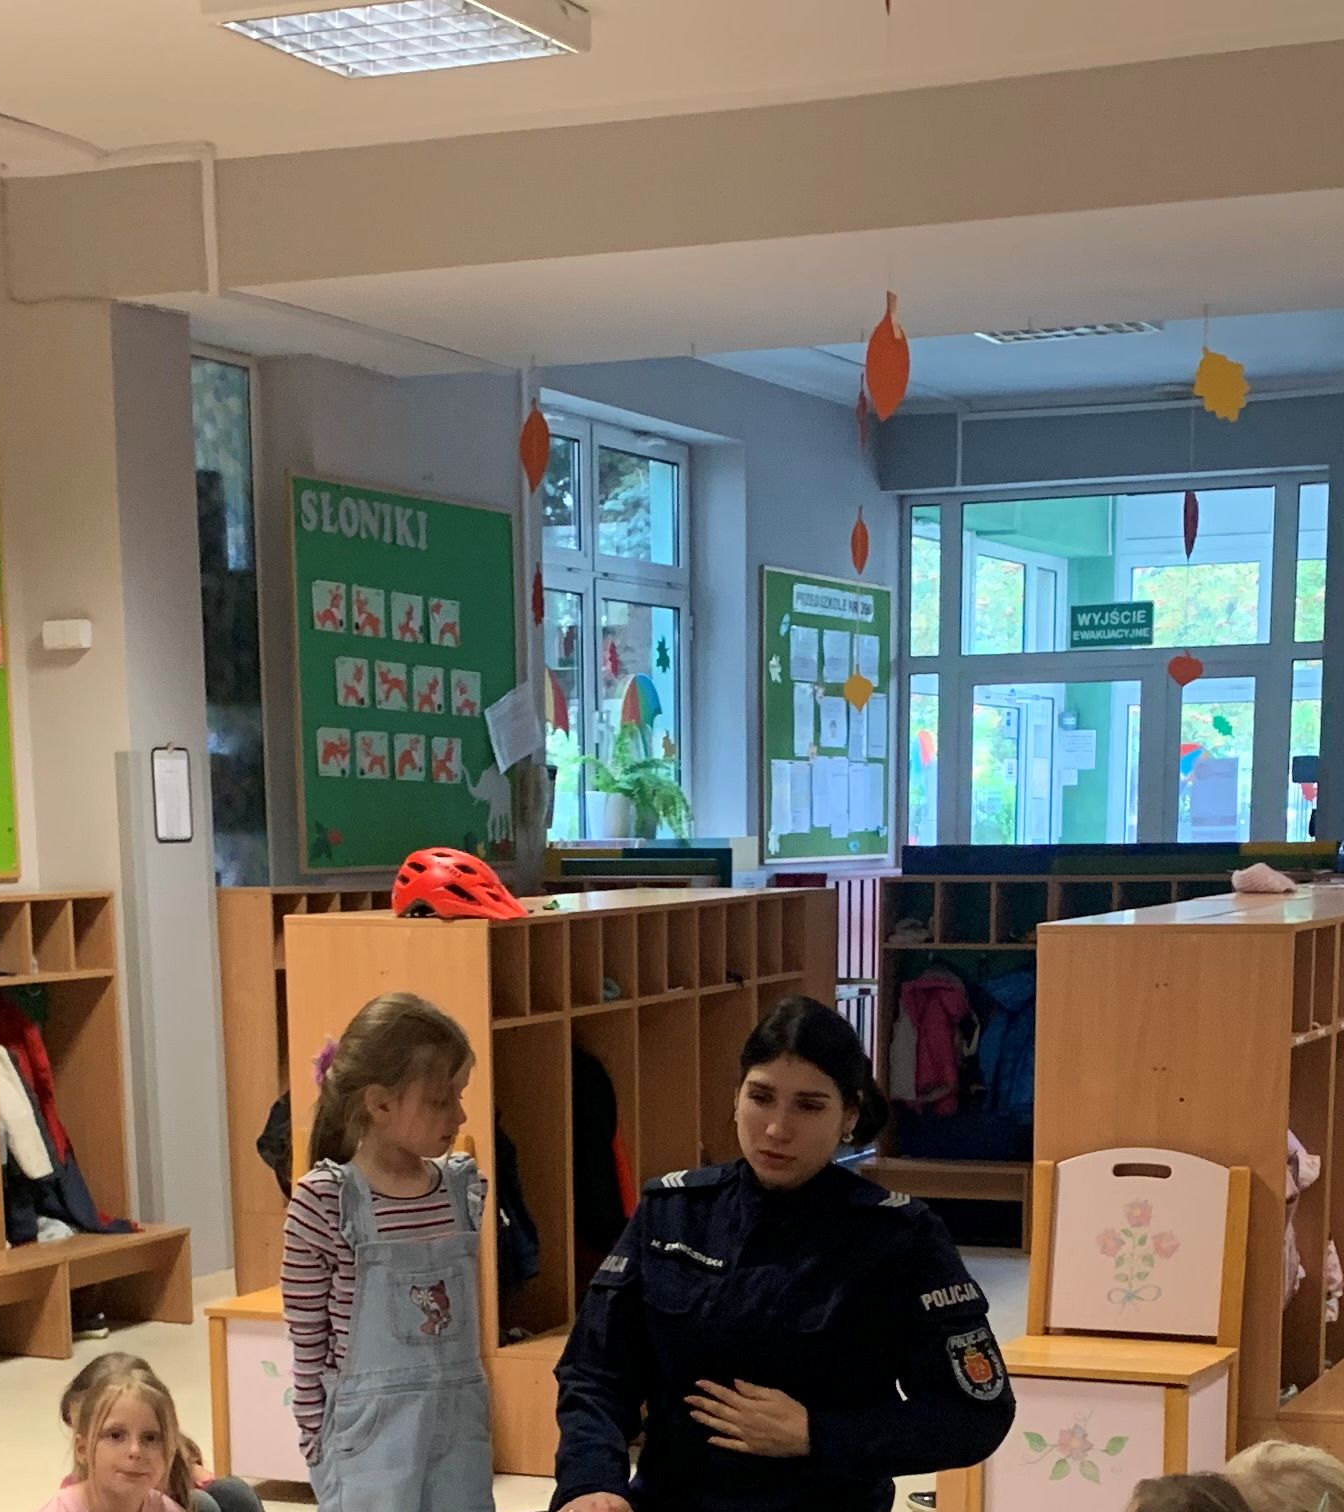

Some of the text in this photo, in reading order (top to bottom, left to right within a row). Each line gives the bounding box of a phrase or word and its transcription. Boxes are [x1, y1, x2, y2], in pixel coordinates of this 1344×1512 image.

[301, 489, 428, 551] SŁONIKI
[1077, 607, 1147, 626] WYJŚCIE
[1073, 627, 1150, 641] EWAKUACYJNE
[920, 1282, 980, 1311] POLICJA
